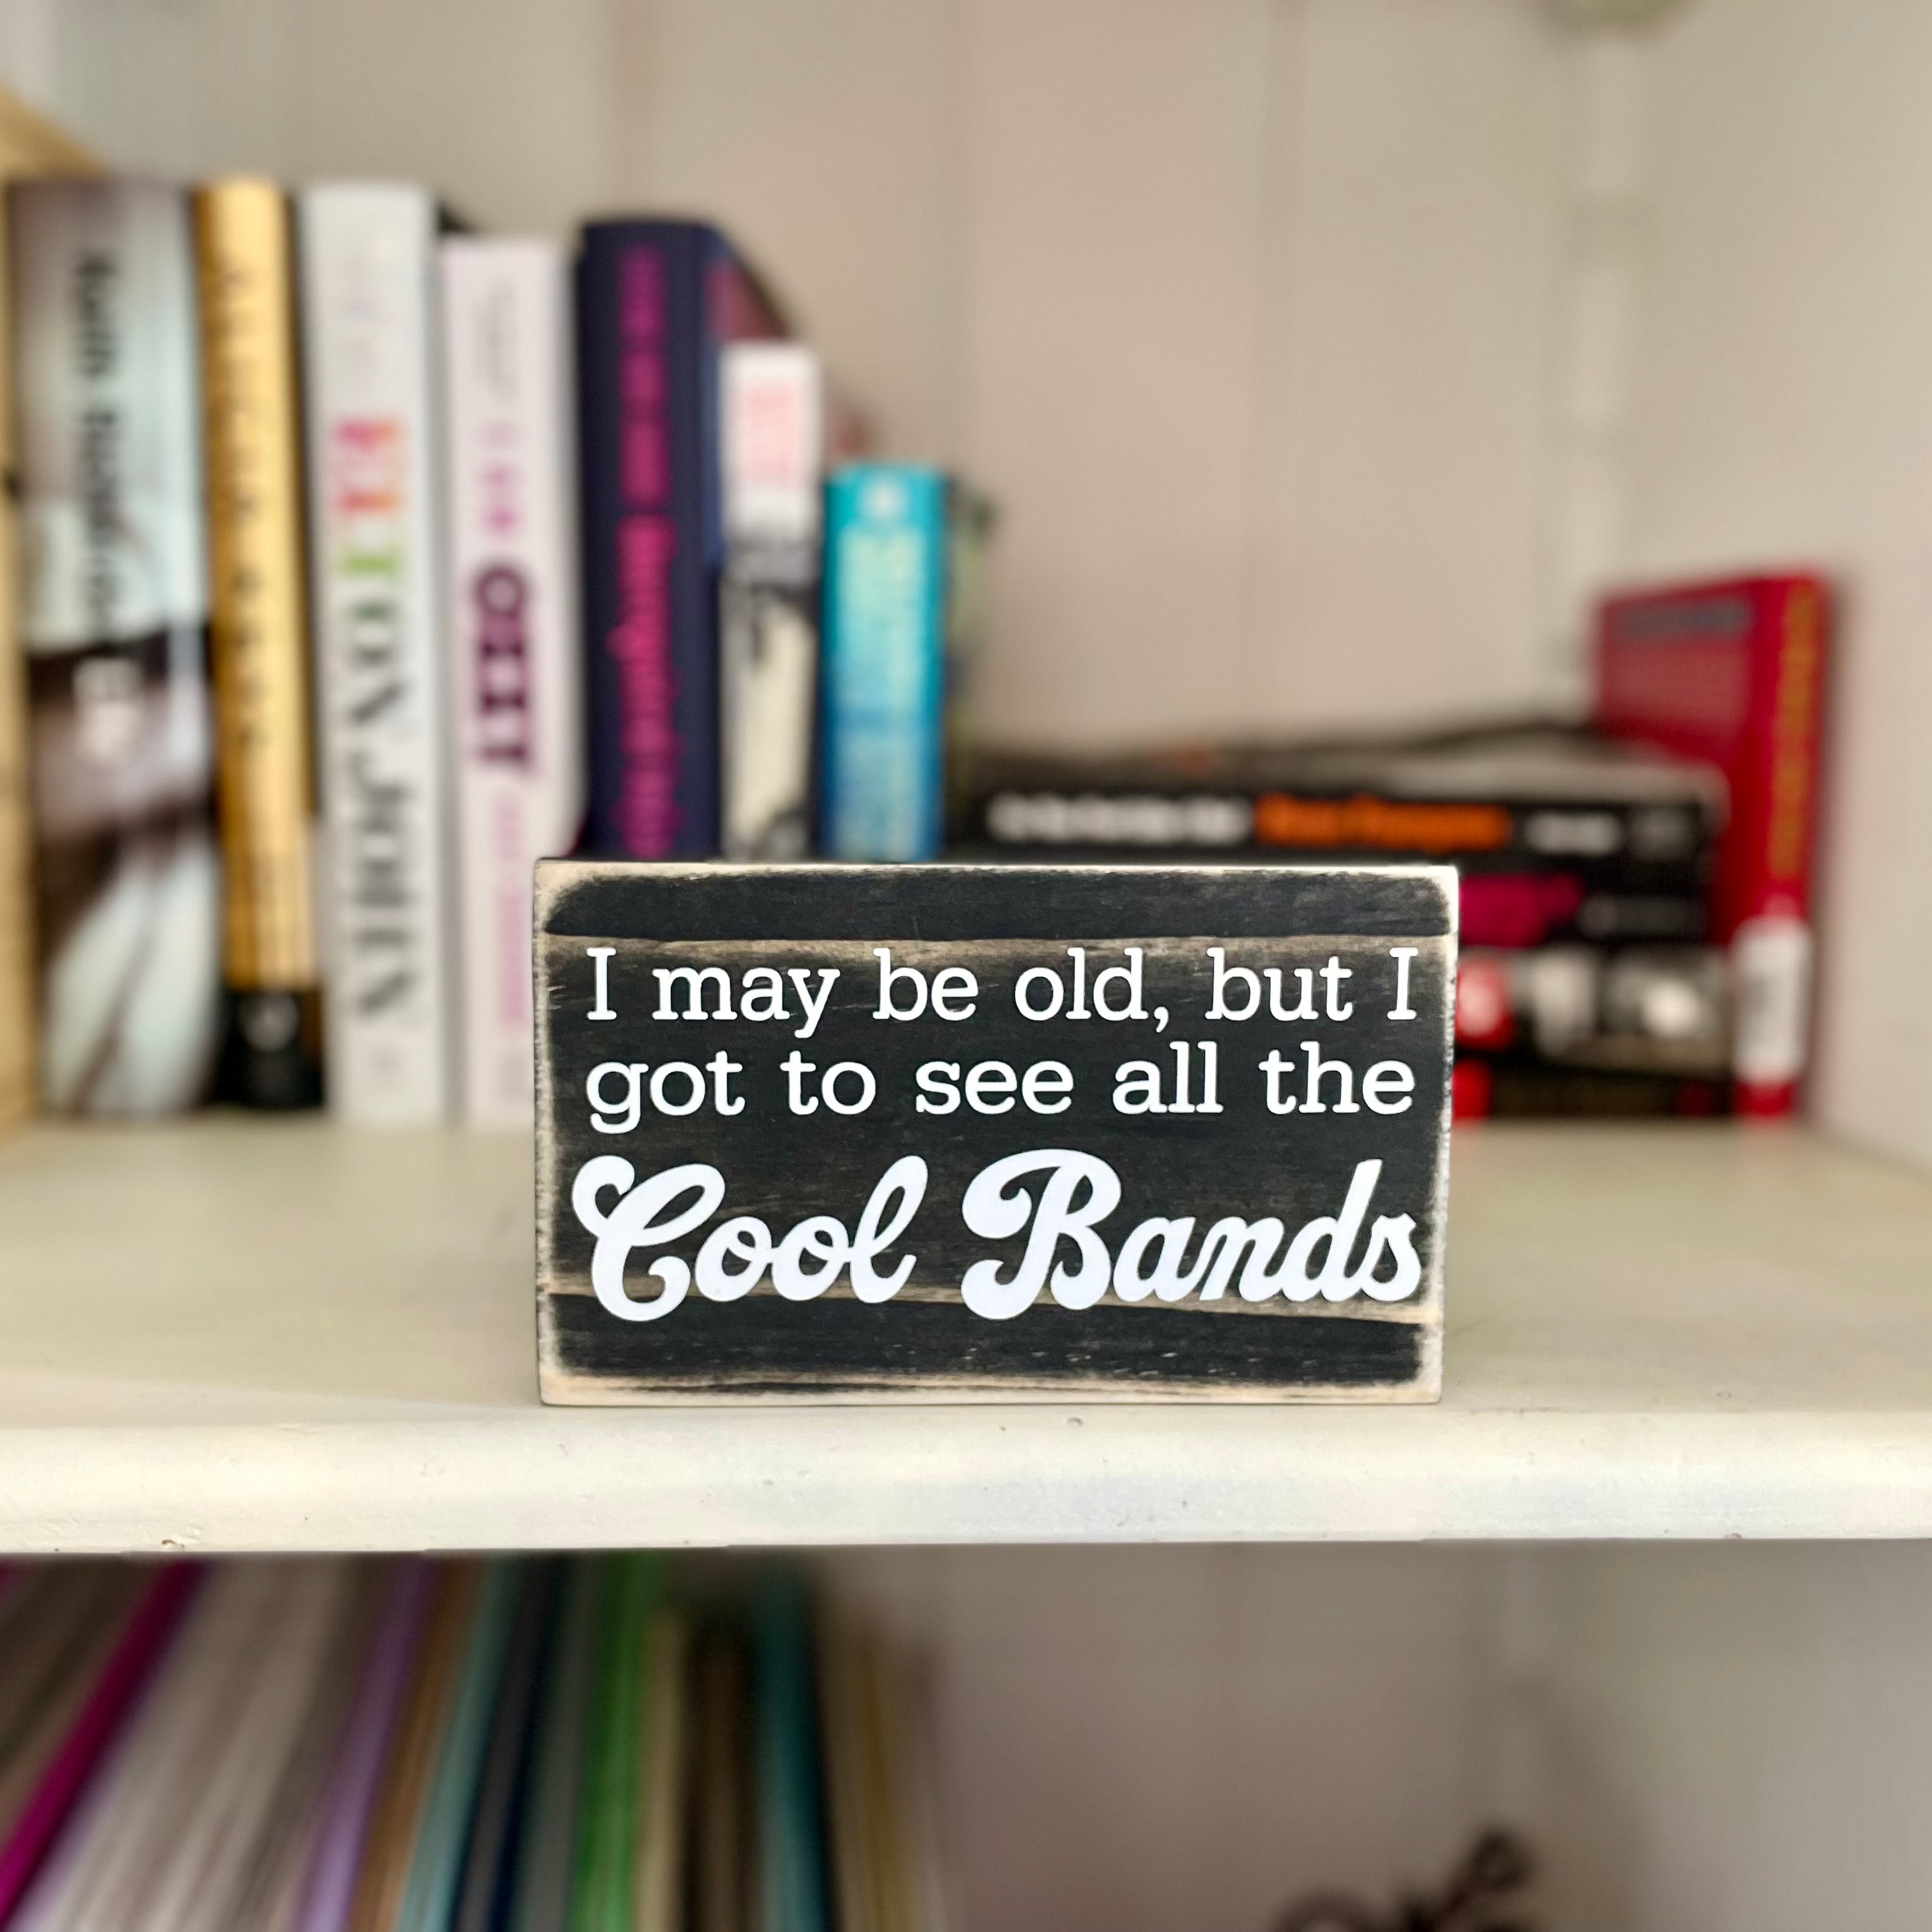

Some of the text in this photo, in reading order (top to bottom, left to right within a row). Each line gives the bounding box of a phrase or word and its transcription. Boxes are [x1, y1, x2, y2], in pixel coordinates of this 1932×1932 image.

[335, 417, 412, 732] ELTON
[586, 947, 1419, 1038] I may be old, but I
[586, 1041, 1415, 1134] got to see all the
[572, 1149, 1422, 1321] Cool Bands
